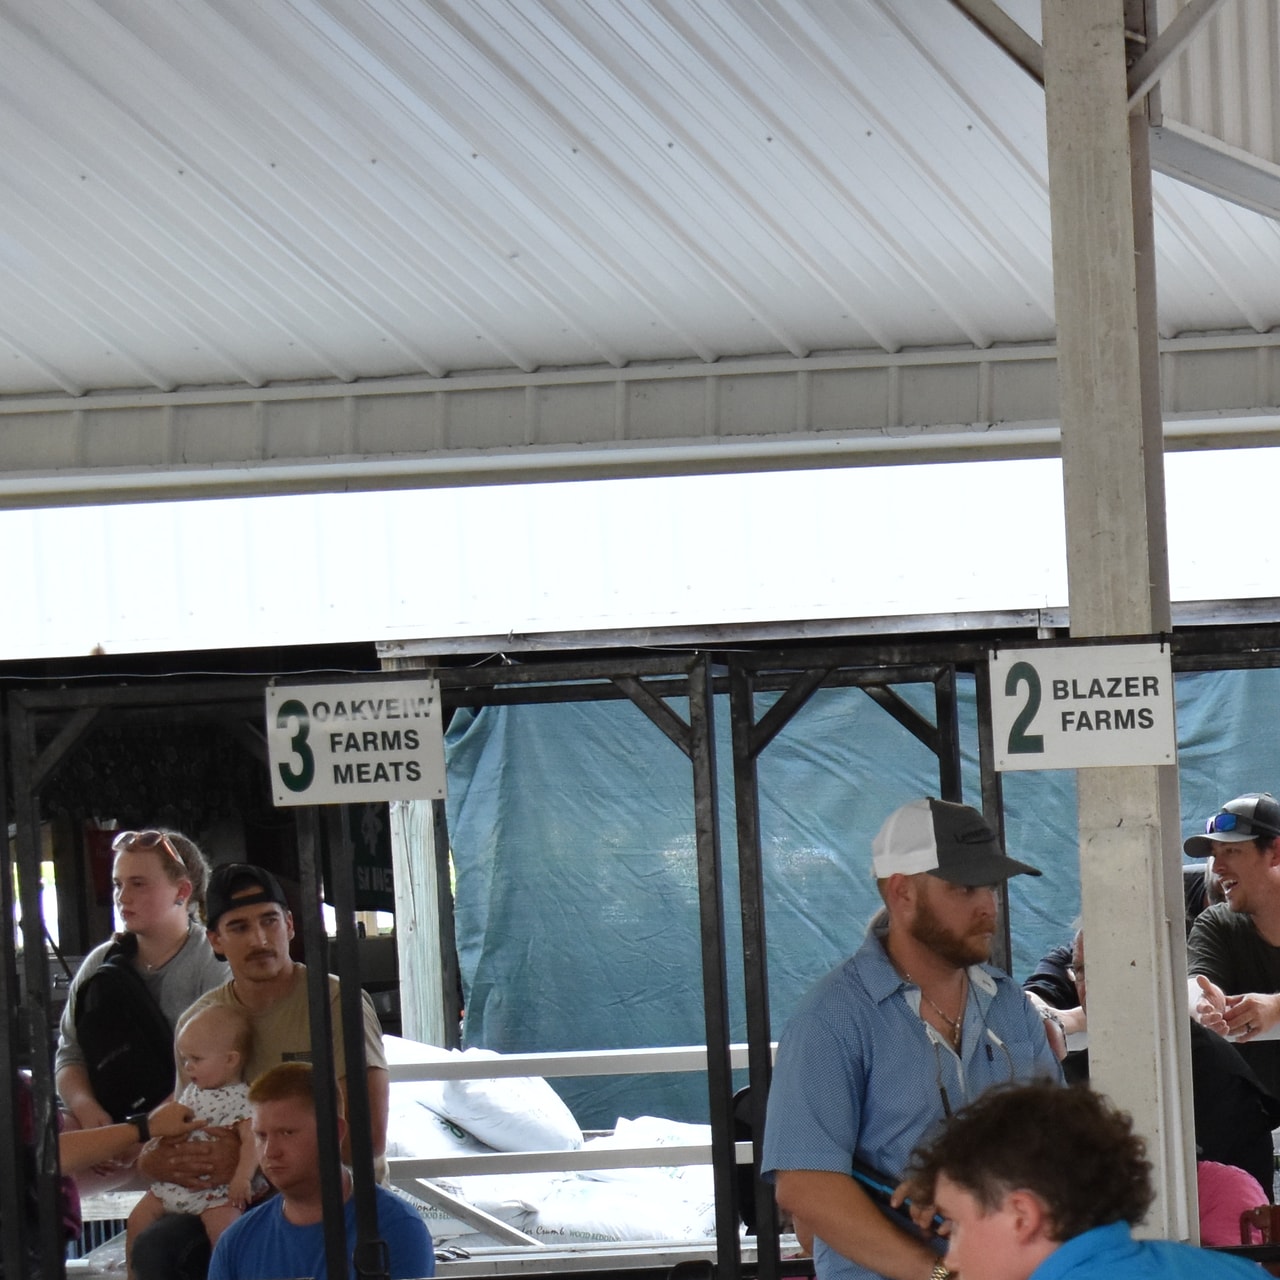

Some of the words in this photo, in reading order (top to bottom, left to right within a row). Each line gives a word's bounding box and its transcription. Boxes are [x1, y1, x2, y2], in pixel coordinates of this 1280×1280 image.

[1052, 675, 1160, 700] BLAZER
[312, 697, 434, 723] OAKVEIW
[1004, 661, 1044, 755] 2
[1061, 707, 1155, 732] FARMS
[276, 699, 316, 793] 3
[329, 729, 420, 753] FARMS
[333, 760, 422, 784] MEATS
[536, 1225, 566, 1237] Crumb
[569, 1229, 591, 1240] WOOD
